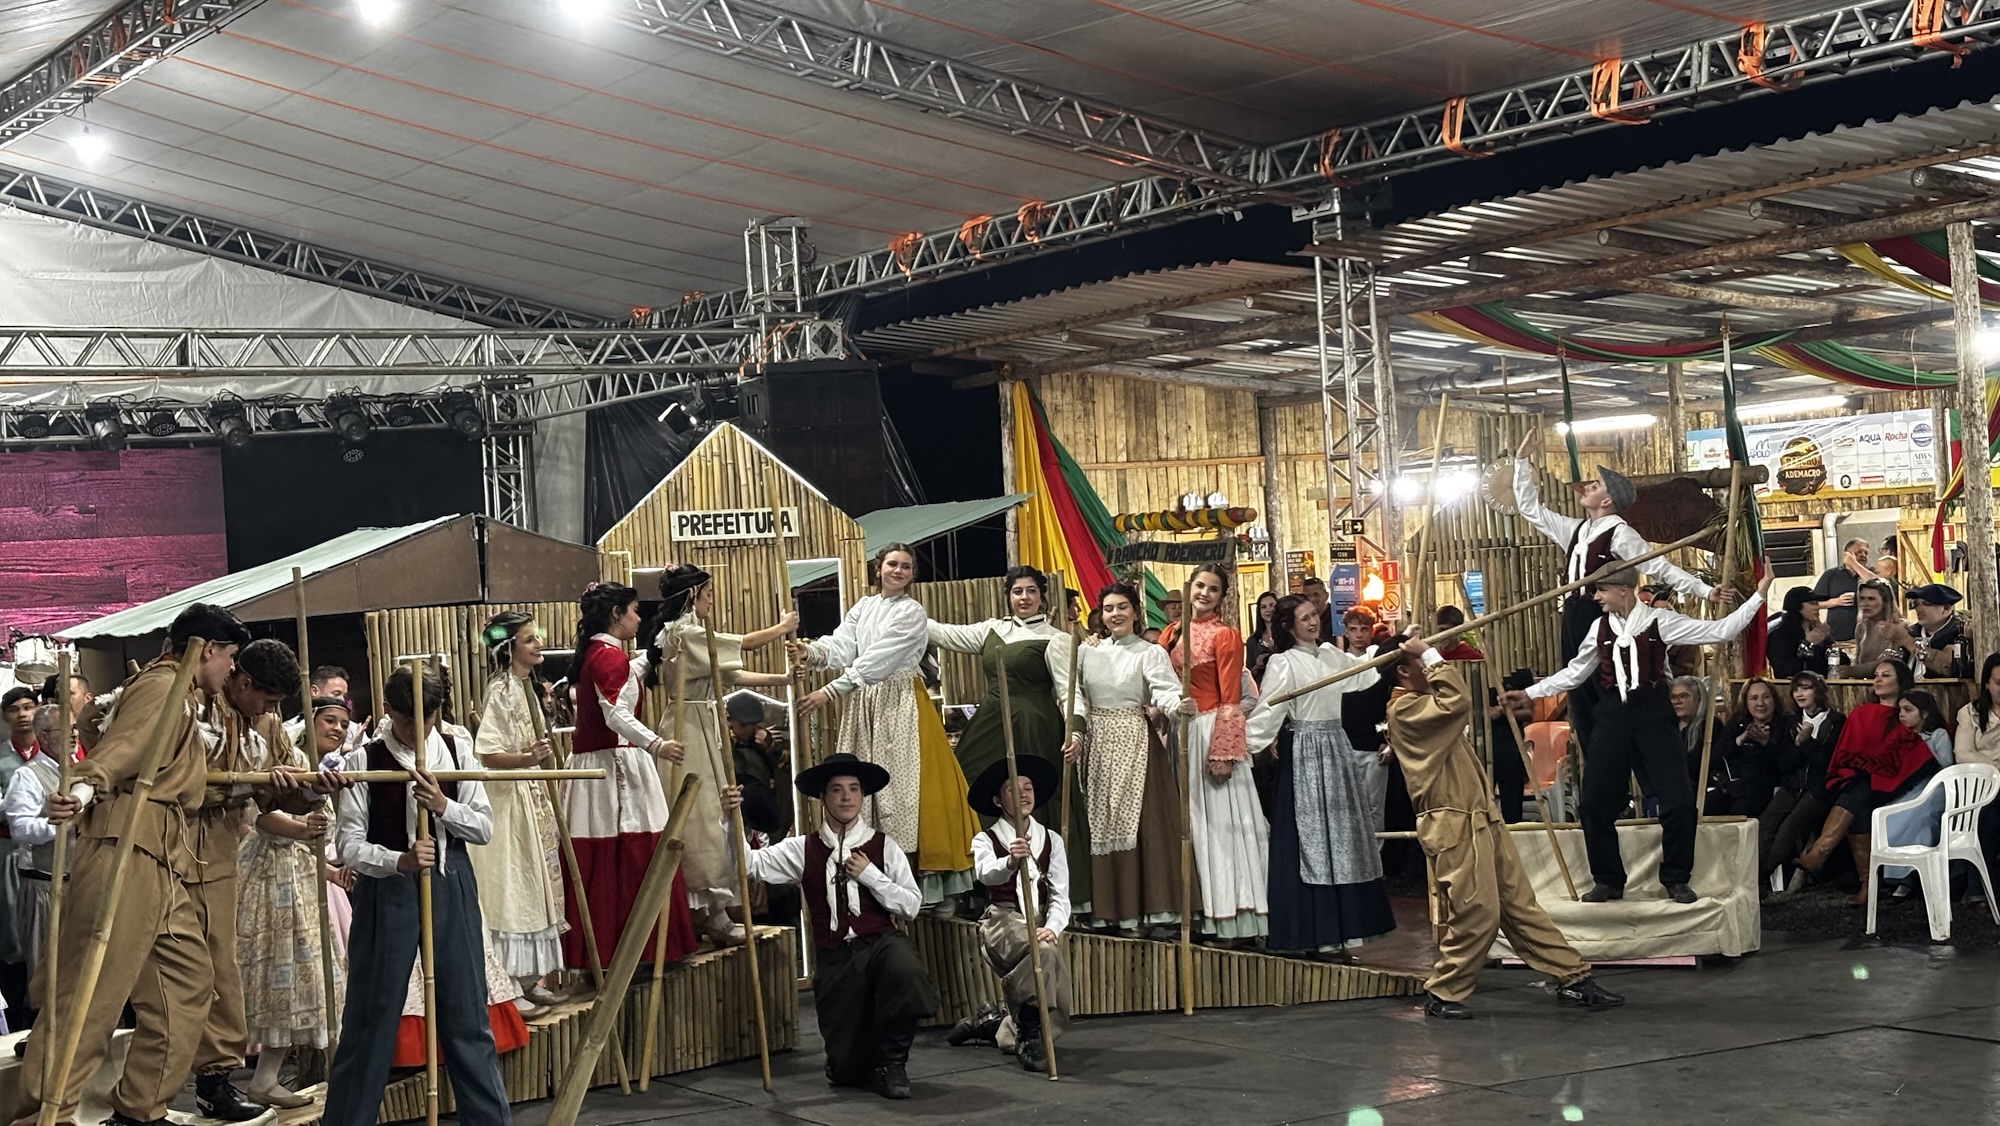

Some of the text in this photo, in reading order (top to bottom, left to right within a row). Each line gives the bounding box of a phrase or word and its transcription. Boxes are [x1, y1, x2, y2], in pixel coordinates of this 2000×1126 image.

[1859, 433, 1882, 443] AQUA
[1885, 431, 1908, 441] Rocha
[1785, 468, 1821, 479] ADEMACRO
[677, 511, 793, 537] PREFEITURA
[1115, 541, 1228, 564] RANCHO ADEMACRO
